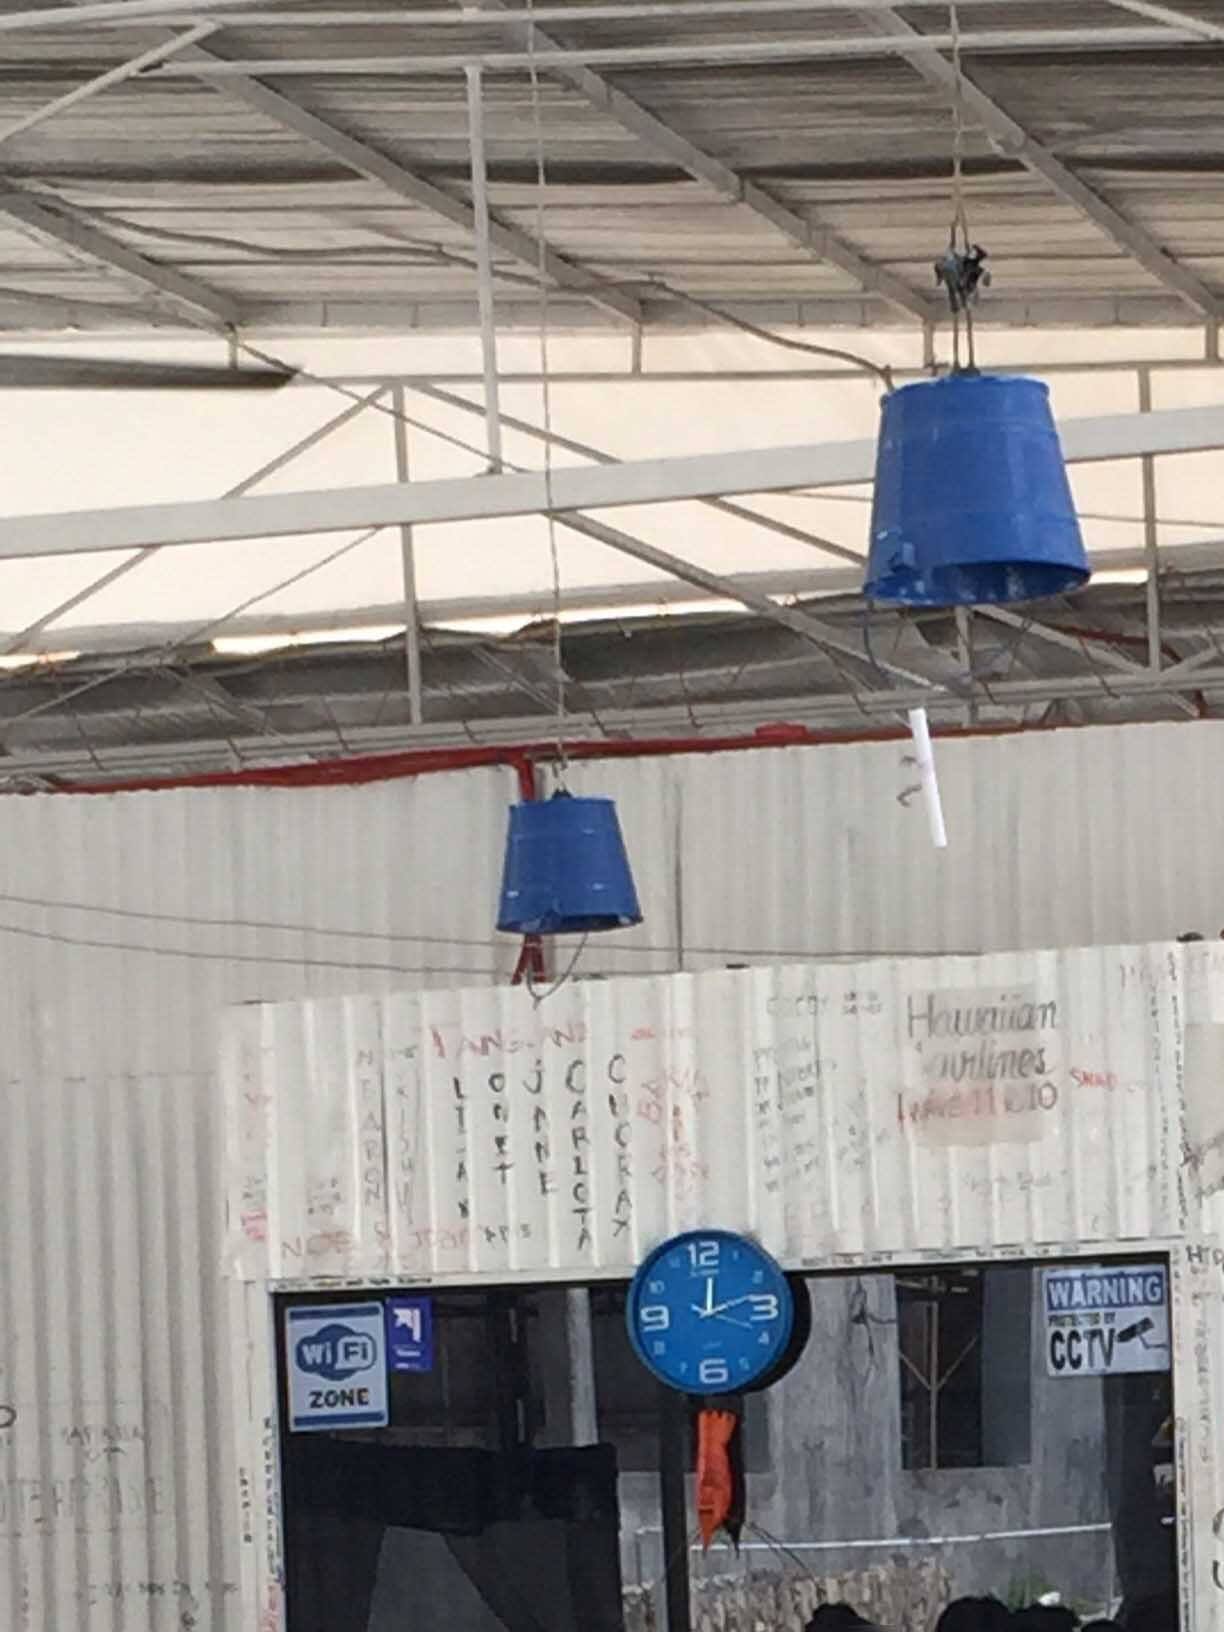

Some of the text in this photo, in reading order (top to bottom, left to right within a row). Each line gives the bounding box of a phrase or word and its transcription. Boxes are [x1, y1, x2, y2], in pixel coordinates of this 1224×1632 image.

[687, 1240, 720, 1268] 12
[1048, 1274, 1162, 1308] WARNING
[640, 1304, 670, 1333] 9
[749, 1293, 779, 1321] 3
[1050, 1327, 1117, 1371] CCTV
[698, 1357, 728, 1385] 6
[309, 1387, 371, 1409] ZONE
